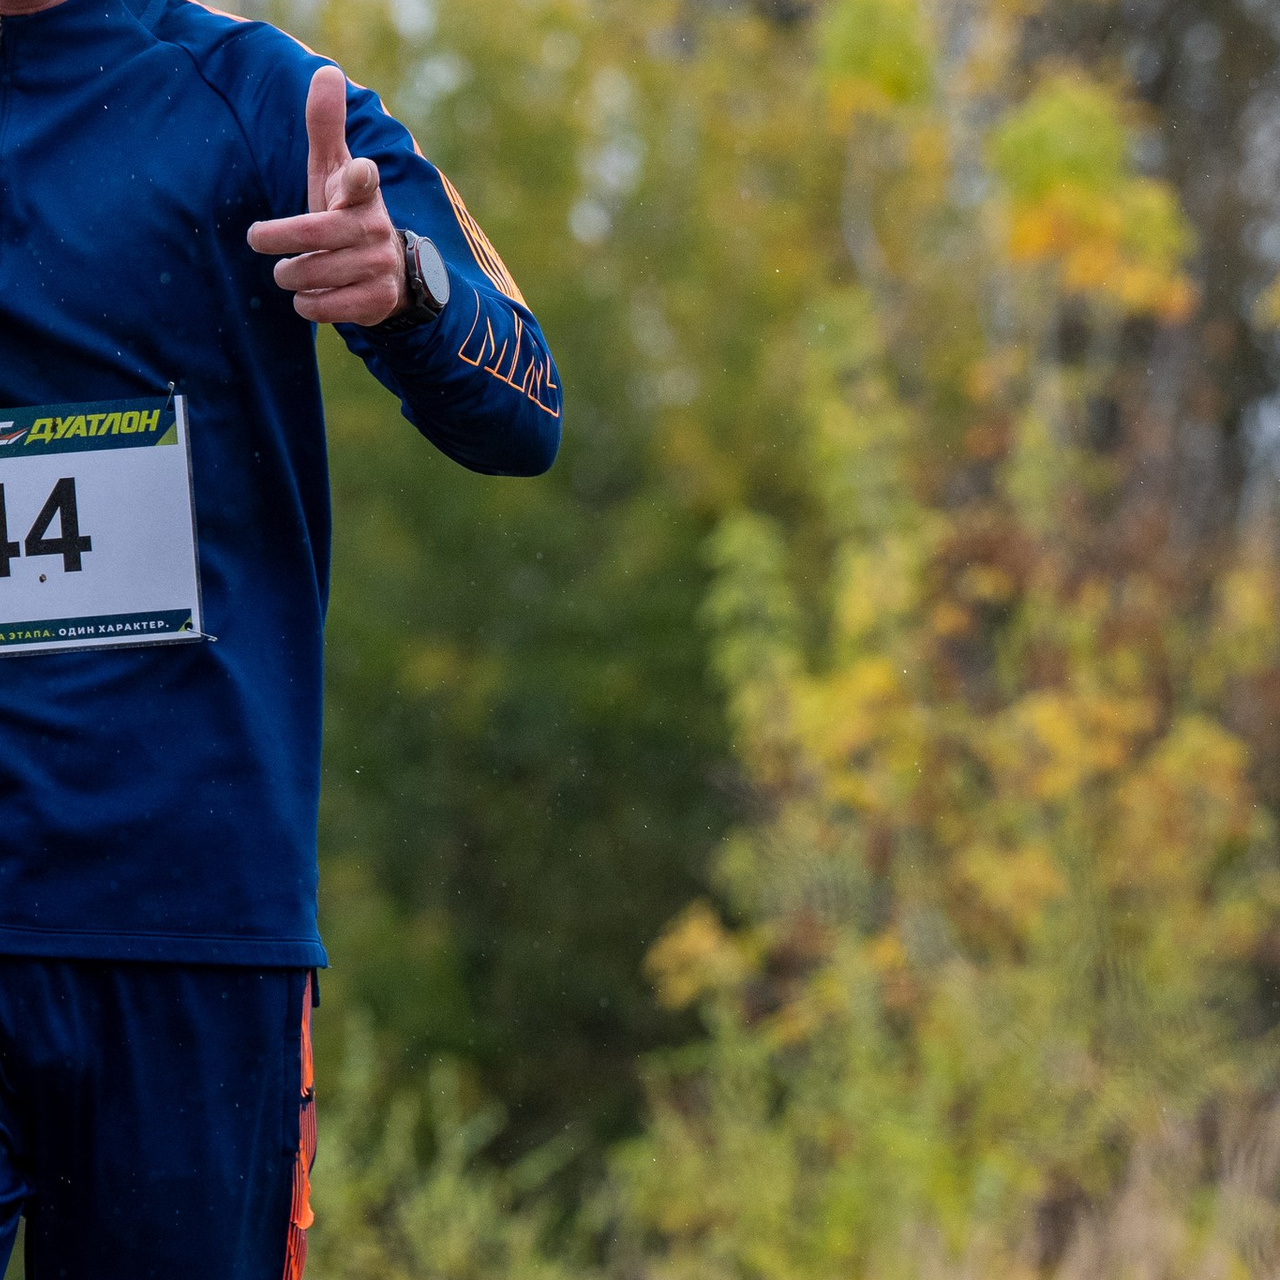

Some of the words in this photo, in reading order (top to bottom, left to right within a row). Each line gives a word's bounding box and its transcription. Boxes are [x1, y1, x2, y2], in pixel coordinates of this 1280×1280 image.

[24, 409, 161, 446] ДУАТЛОН
[9, 629, 56, 641] ЭТАПА.
[58, 626, 95, 637] ОДИН
[98, 620, 170, 634] ХАРАКТЕР.
